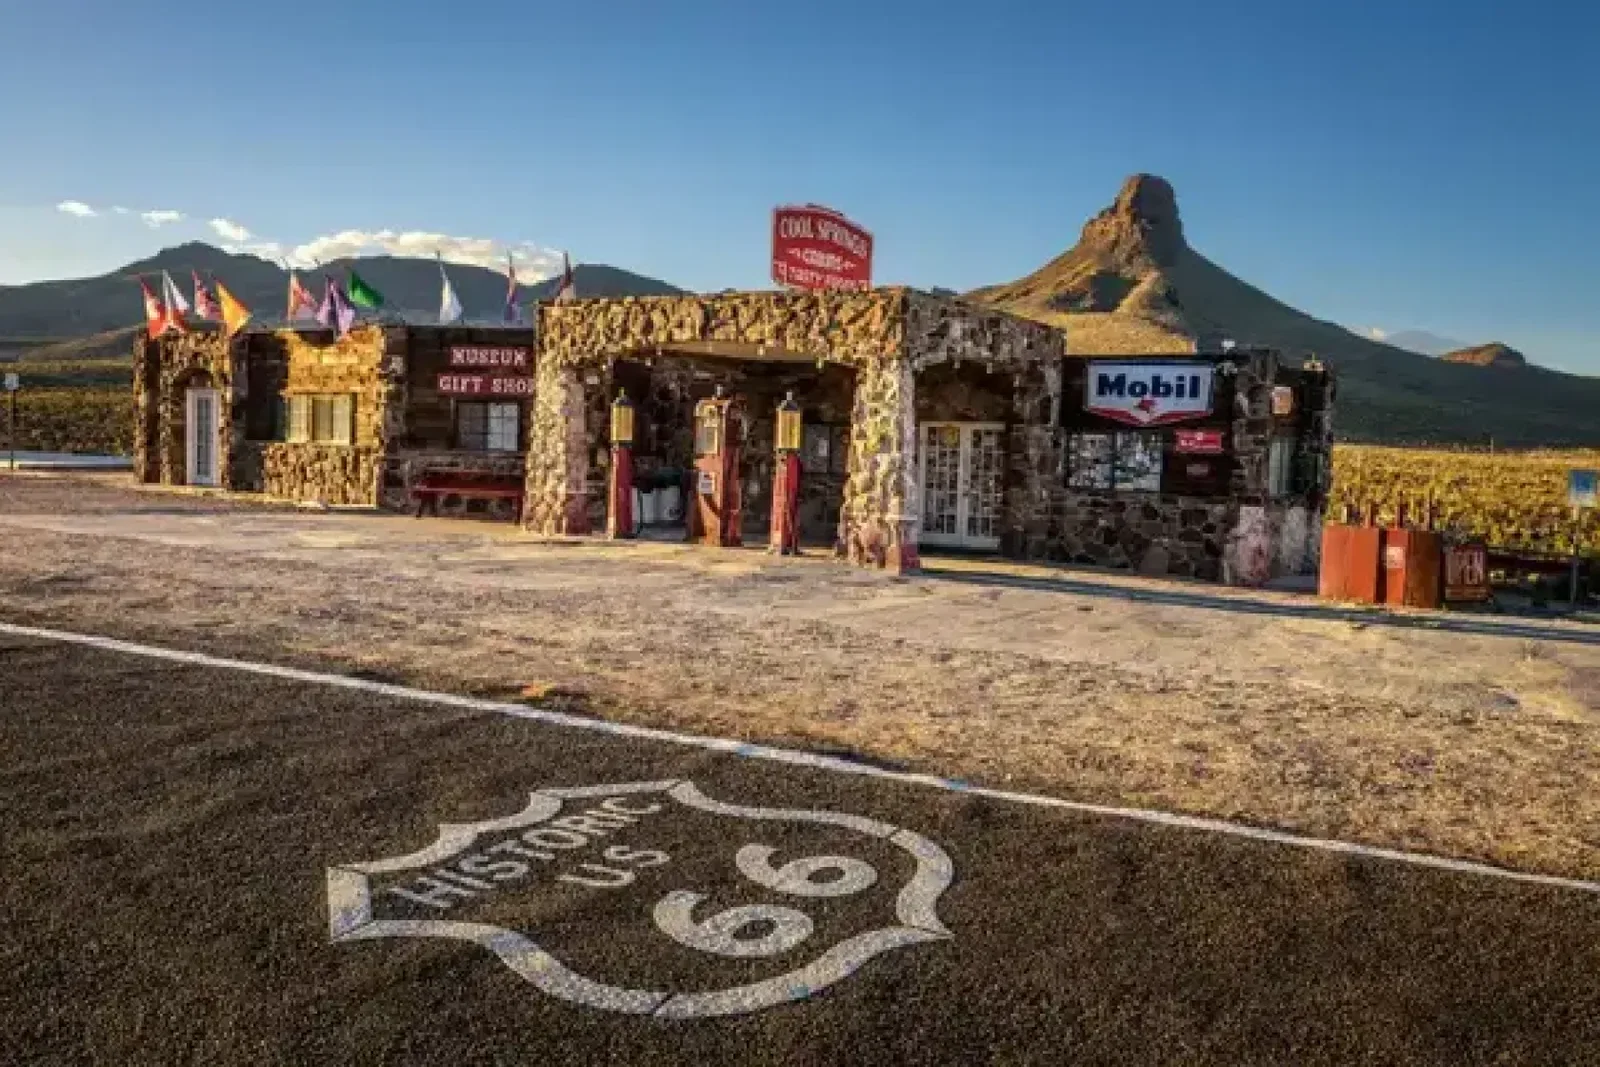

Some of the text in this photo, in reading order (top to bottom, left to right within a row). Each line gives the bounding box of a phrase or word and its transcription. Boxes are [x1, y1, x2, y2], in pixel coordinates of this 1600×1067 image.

[780, 216, 813, 238] COOL
[452, 349, 526, 366] MUSEUM
[439, 375, 483, 393] GIFT
[1096, 373, 1201, 398] Mobil
[391, 797, 662, 908] HISTORIC
[555, 845, 671, 888] US
